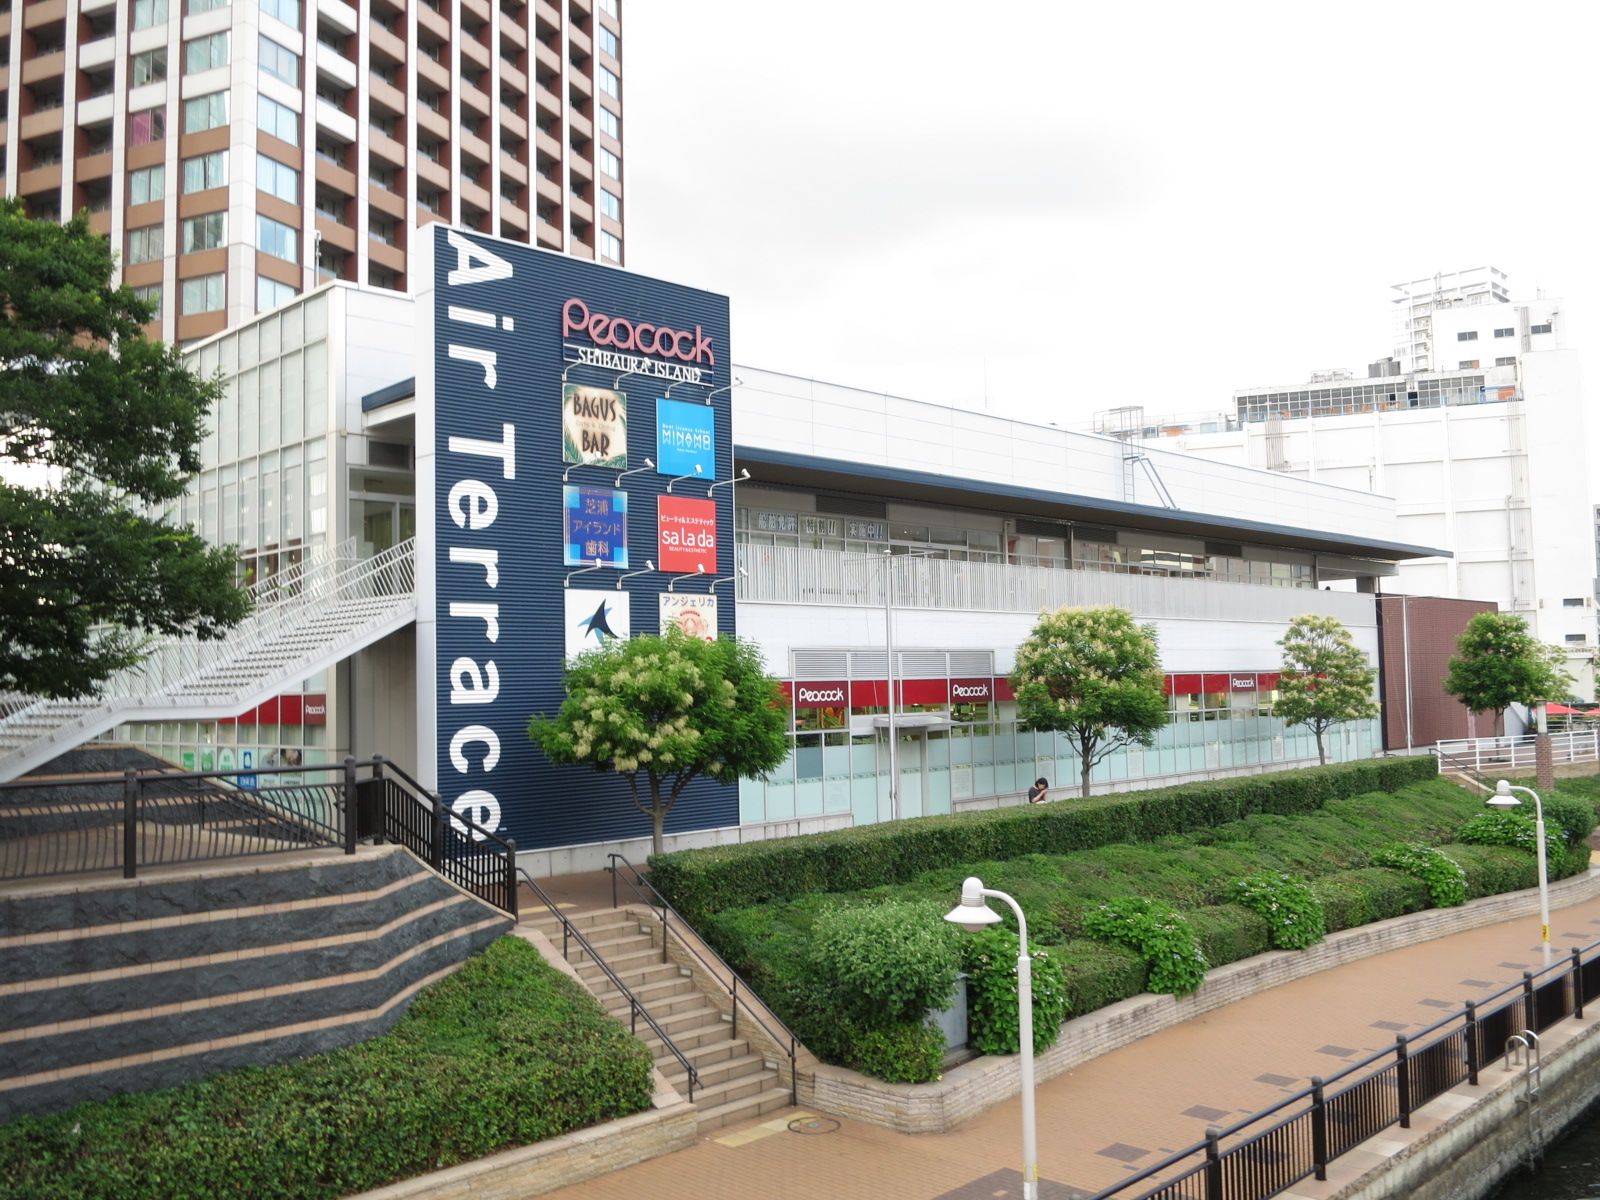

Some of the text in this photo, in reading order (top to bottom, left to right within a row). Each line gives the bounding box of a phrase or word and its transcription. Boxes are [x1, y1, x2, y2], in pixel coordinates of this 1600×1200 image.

[562, 298, 715, 366] Peacock
[654, 366, 701, 383] ISLAND
[573, 392, 616, 422] BAGUS
[582, 429, 610, 457] BAR
[662, 429, 711, 446] MINAMO
[585, 498, 609, 516] 芝浦
[448, 230, 516, 843] Air Terrace
[573, 520, 621, 536] アイランド
[585, 540, 609, 557] 歯科
[663, 596, 715, 607] アンジェリカ
[799, 687, 844, 702] Peacock
[953, 684, 989, 697] Peacock
